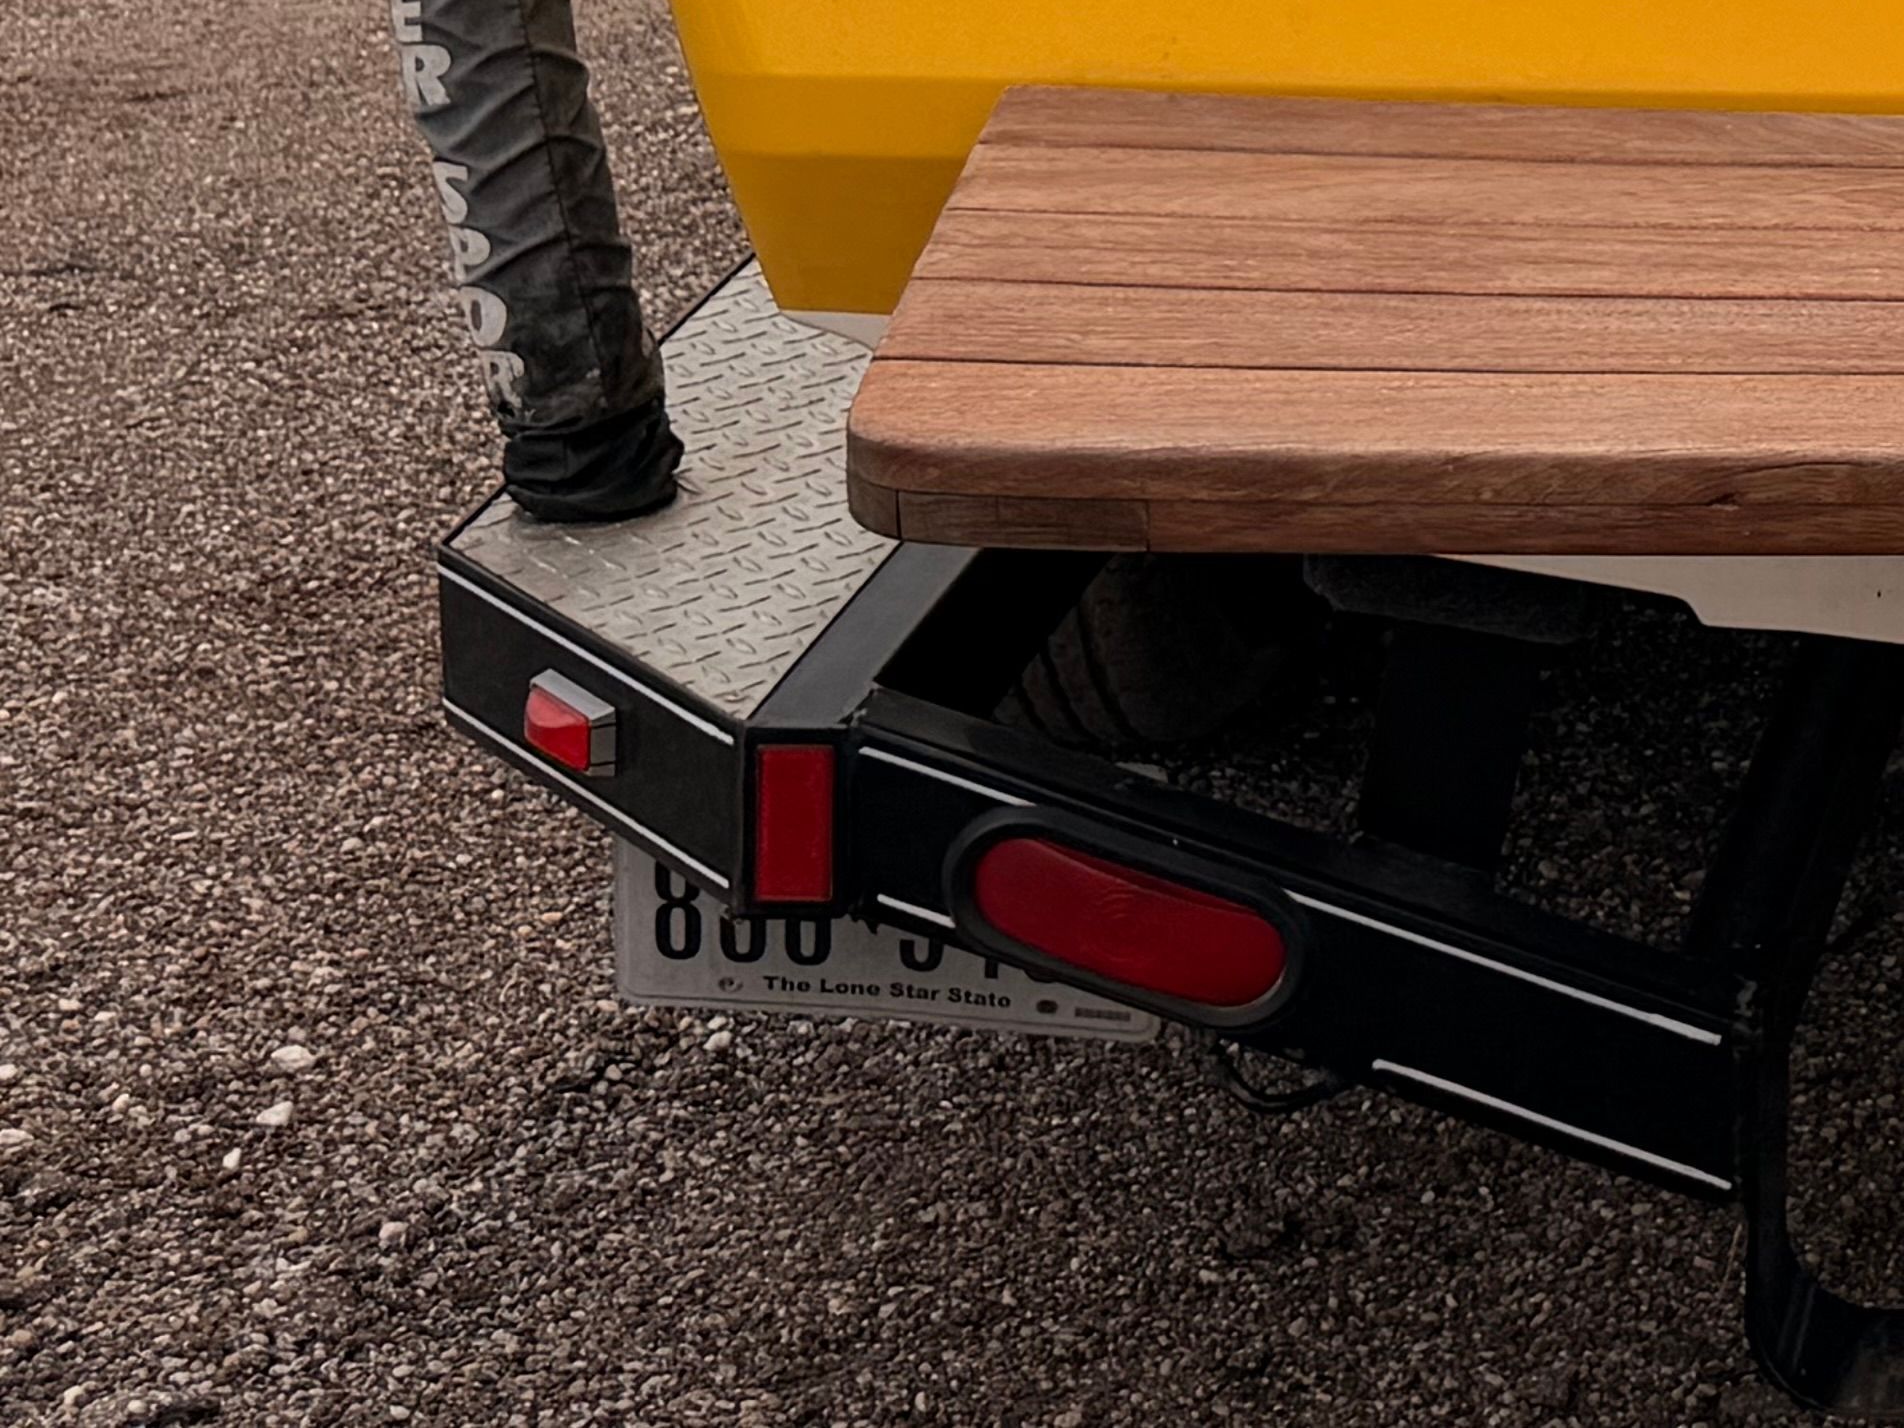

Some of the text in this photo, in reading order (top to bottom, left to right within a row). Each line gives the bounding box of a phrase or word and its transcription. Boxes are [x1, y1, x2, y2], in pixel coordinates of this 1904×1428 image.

[432, 160, 530, 414] SPOR
[763, 975, 810, 994] The
[820, 978, 881, 999] Lone
[890, 981, 947, 1004] Star
